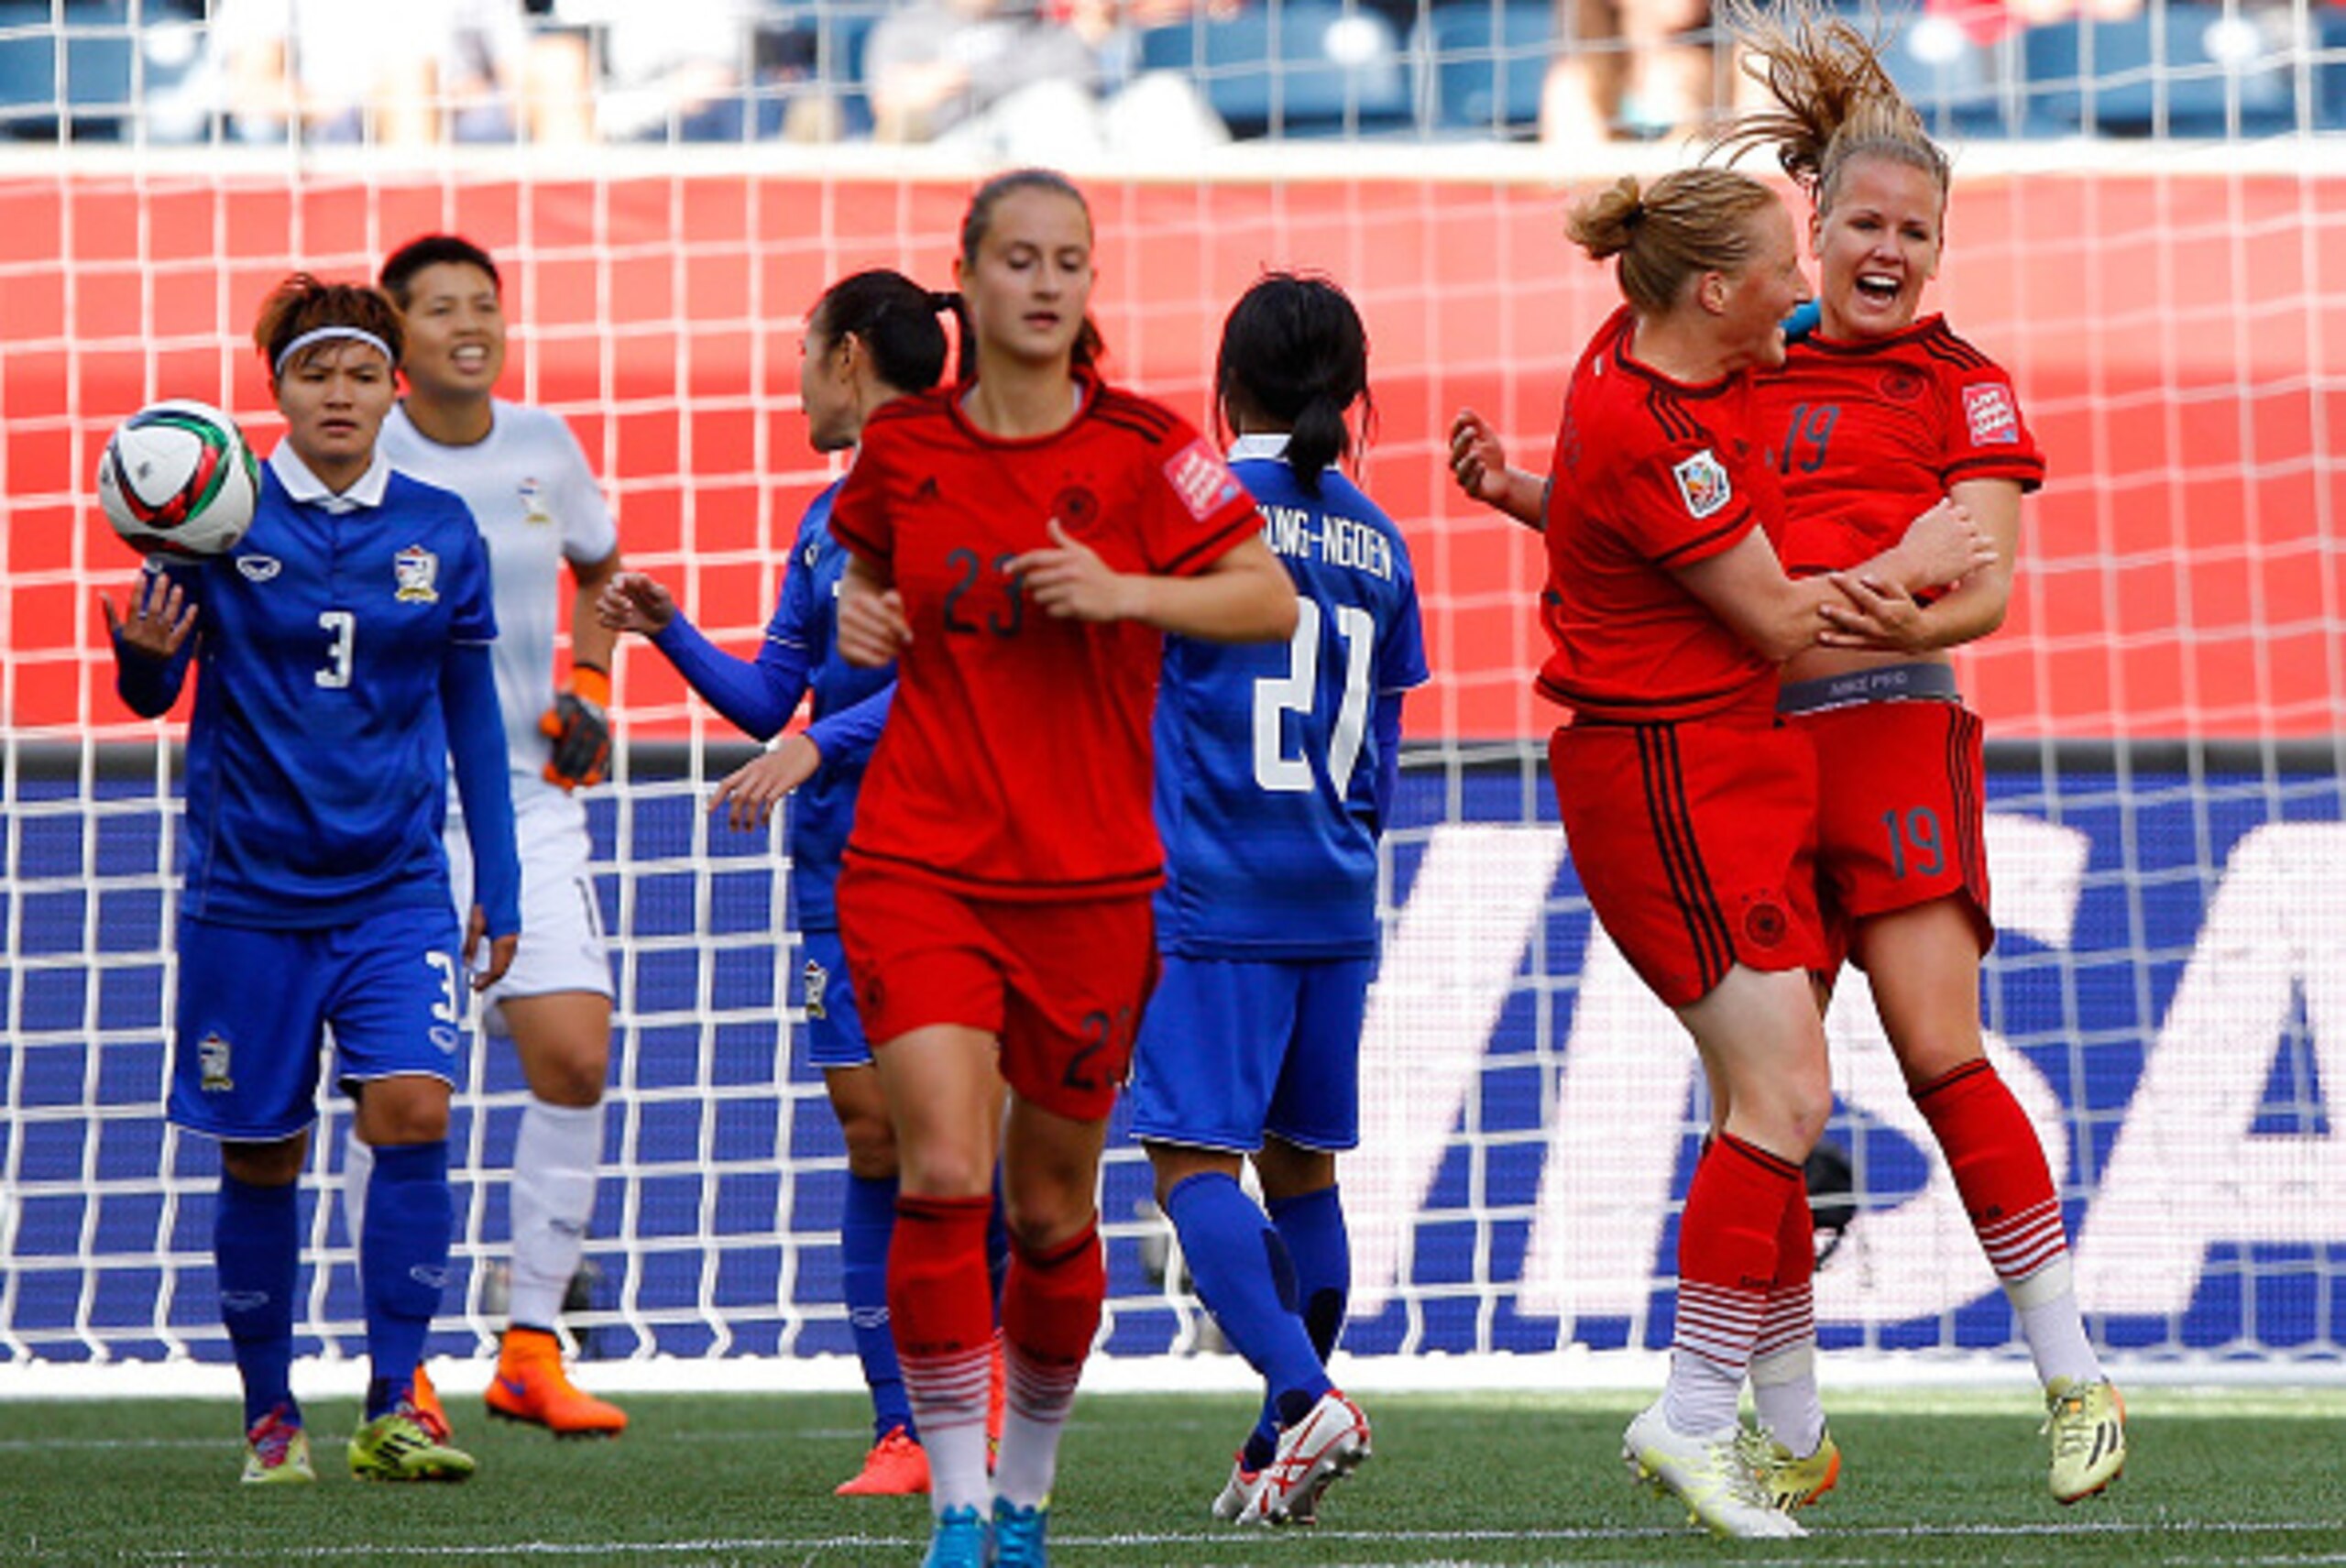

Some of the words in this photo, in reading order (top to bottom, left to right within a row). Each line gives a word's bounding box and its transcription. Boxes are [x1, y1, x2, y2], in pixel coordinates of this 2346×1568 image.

[1781, 403, 1840, 475] 19
[944, 549, 1024, 639] 23
[315, 611, 355, 688] 3
[1880, 806, 1944, 879] 19
[425, 951, 456, 1024] 3
